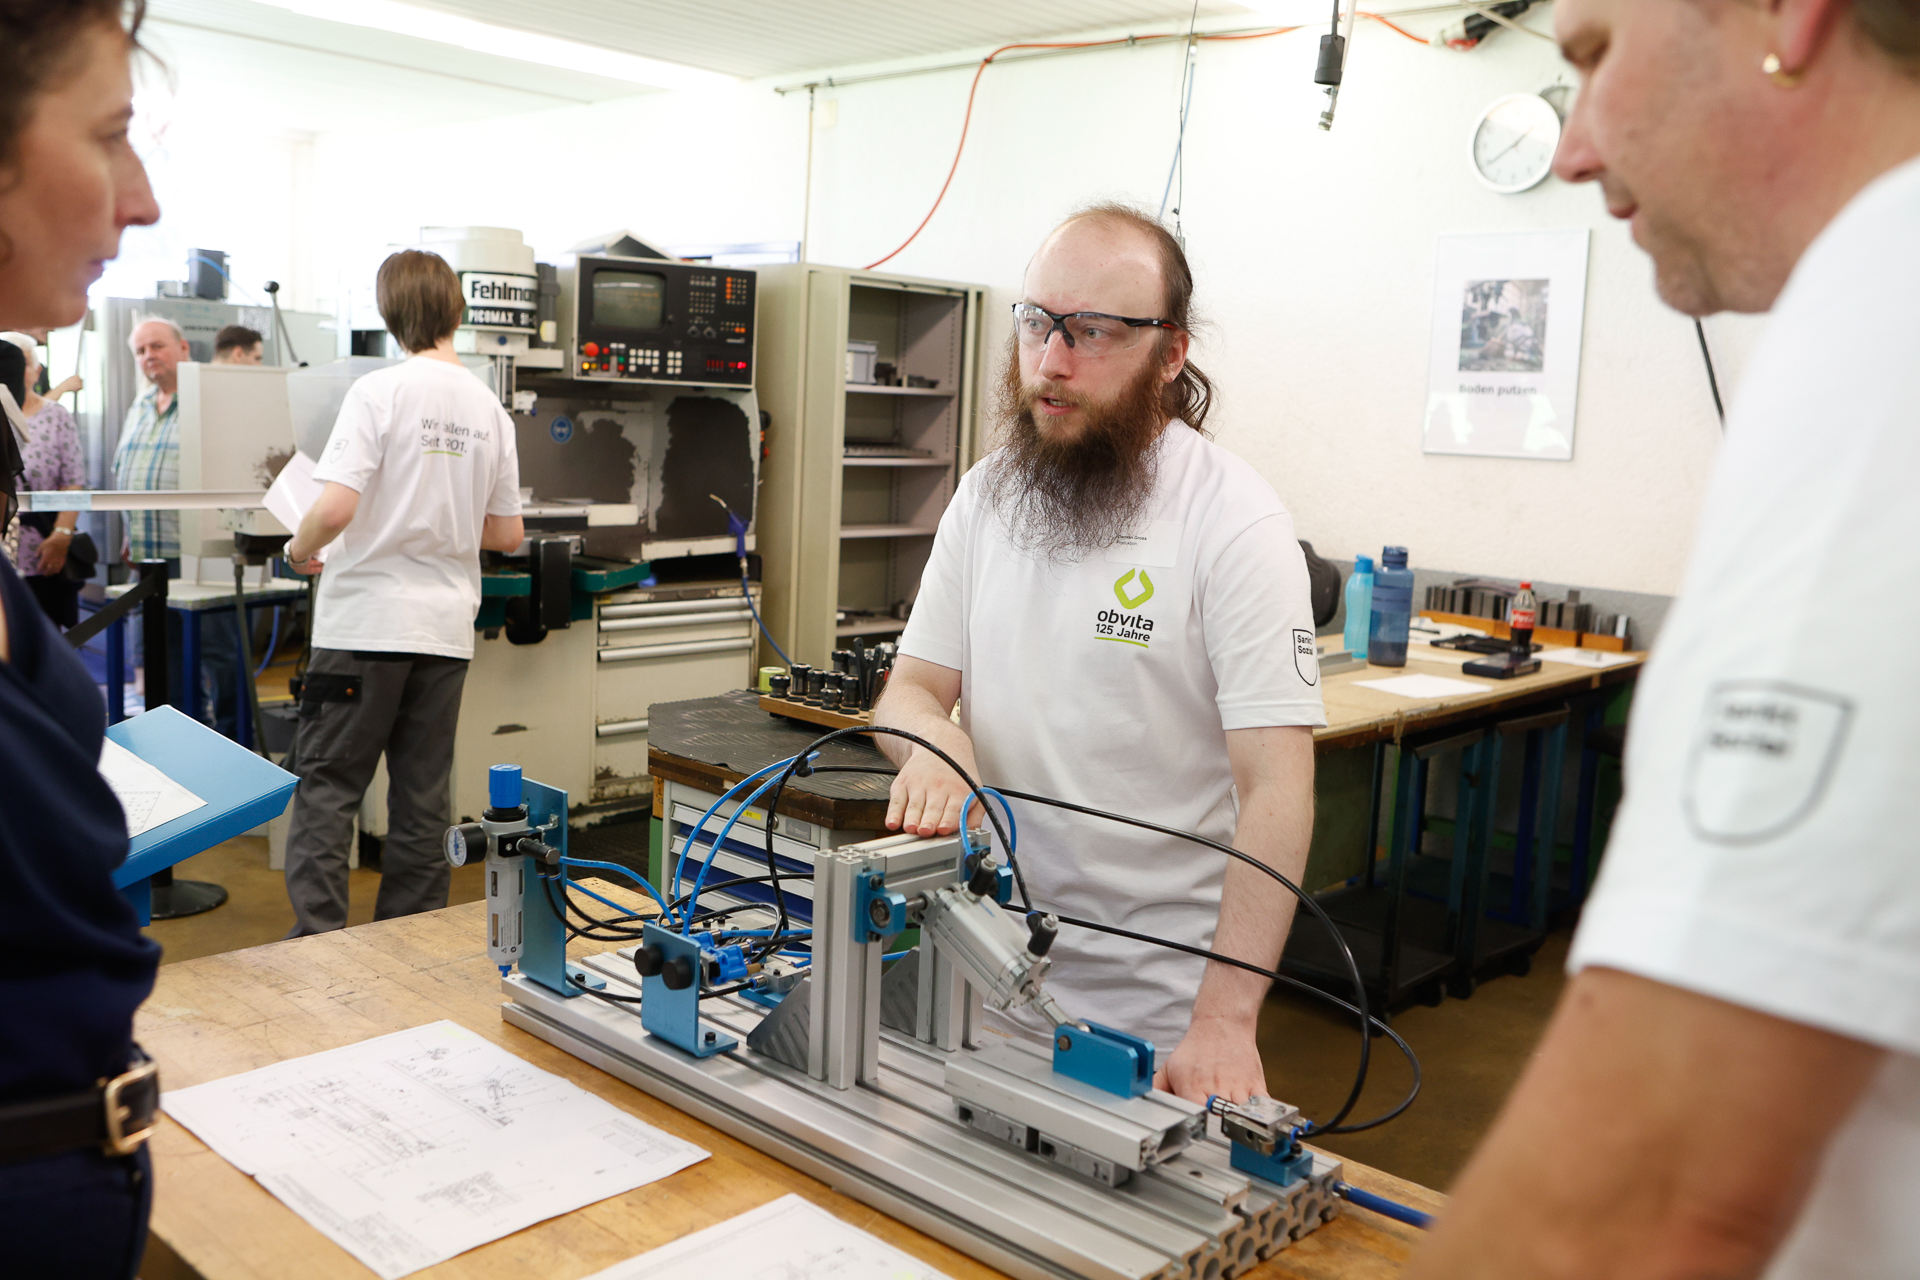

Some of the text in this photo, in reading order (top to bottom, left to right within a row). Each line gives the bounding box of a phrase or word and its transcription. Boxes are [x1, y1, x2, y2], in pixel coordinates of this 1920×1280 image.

[471, 280, 536, 303] Fehlma
[468, 309, 515, 325] PICOMAX
[1097, 609, 1154, 632] obvita
[1095, 623, 1151, 642] 125 Jahre
